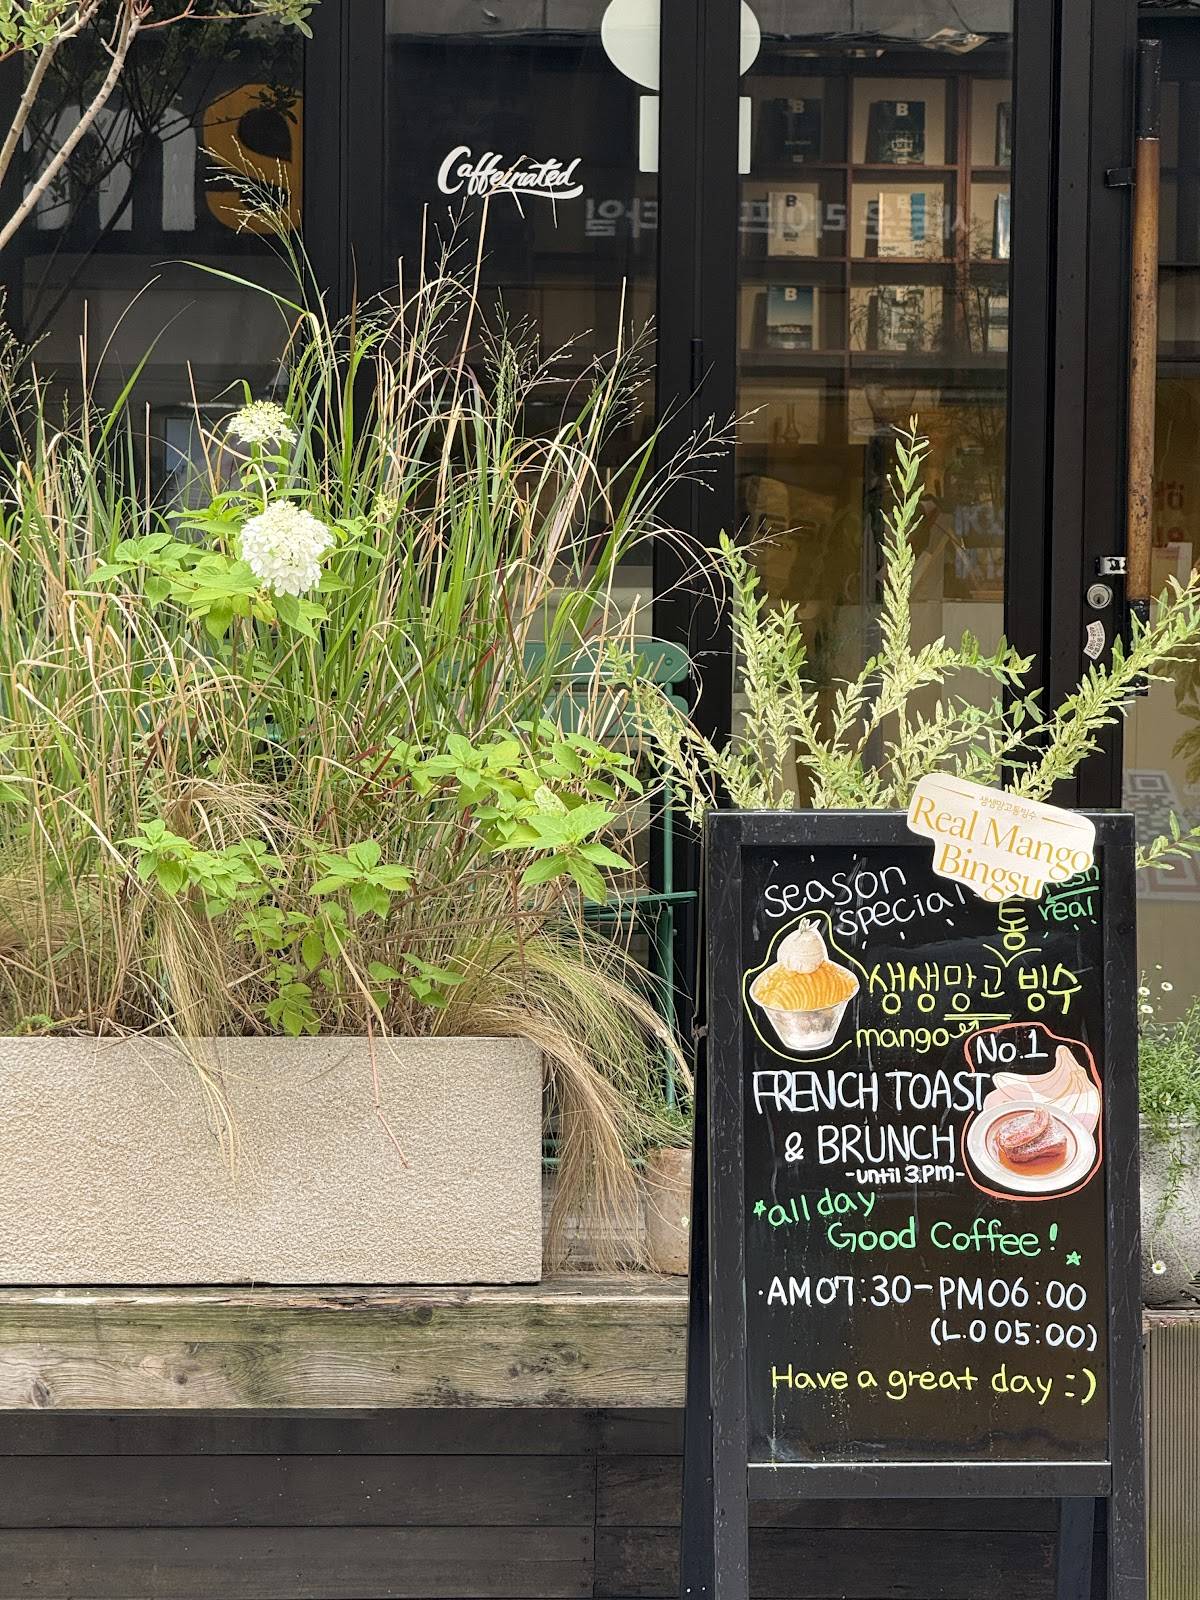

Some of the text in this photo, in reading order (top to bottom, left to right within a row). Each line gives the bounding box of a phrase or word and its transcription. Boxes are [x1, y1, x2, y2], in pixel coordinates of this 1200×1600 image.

[896, 103, 909, 117] B
[437, 145, 584, 200] Caffeinated
[785, 194, 797, 208] B
[785, 287, 798, 302] B
[912, 795, 979, 842] Real
[983, 817, 1092, 882] Mango
[764, 866, 907, 919] season
[939, 842, 1043, 901] Bingsu
[836, 884, 967, 937] special
[1038, 896, 1094, 922] real
[868, 962, 1083, 1016] 생생망고 빙수
[856, 1026, 950, 1055] mango
[976, 1028, 1048, 1064] No.1
[752, 1069, 992, 1114] FRENCH TOAST
[783, 1123, 956, 1165] & BRUNCH
[767, 1188, 876, 1228] all day
[827, 1216, 917, 1254] Good
[771, 1363, 849, 1391] Have
[857, 1370, 878, 1389] a
[887, 1366, 979, 1400] great
[991, 1363, 1053, 1405] day
